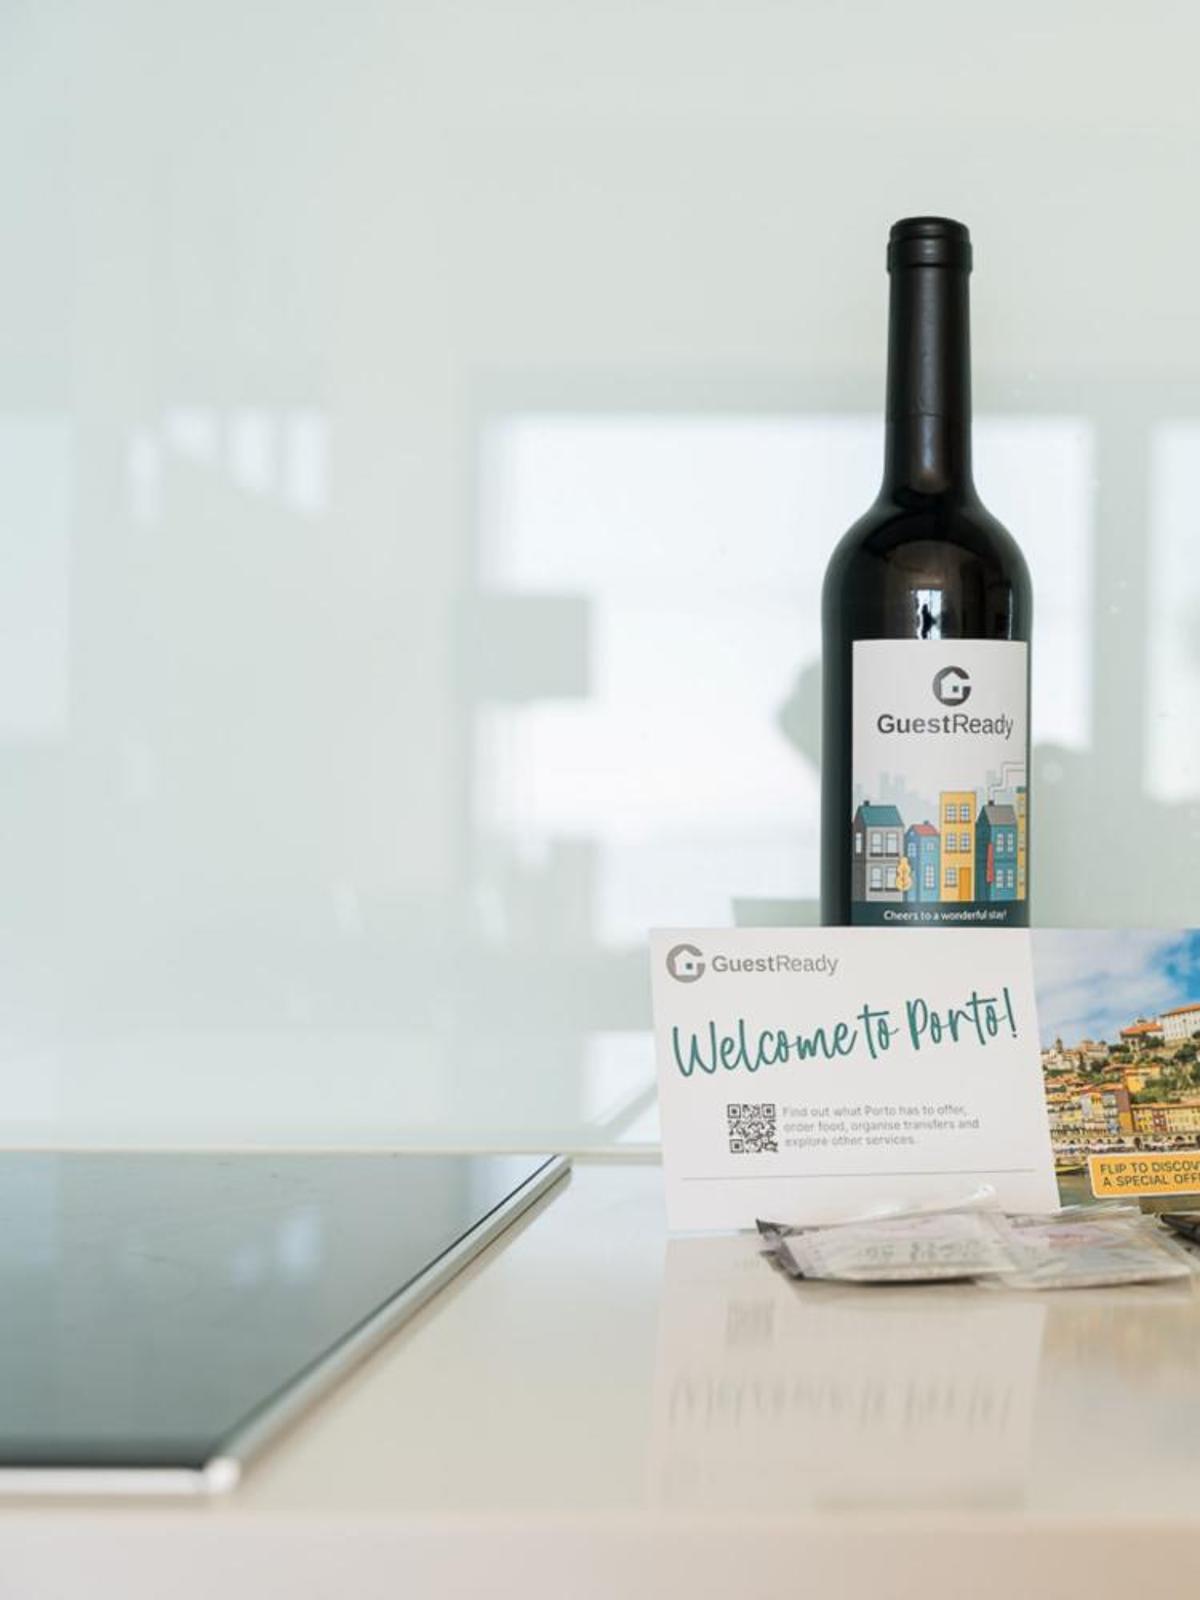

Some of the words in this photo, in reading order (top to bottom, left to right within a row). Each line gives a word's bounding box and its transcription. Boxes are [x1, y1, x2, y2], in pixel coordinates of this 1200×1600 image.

[877, 713, 1013, 740] GuestReady
[883, 909, 918, 921] Cheers
[920, 910, 932, 921] to
[933, 912, 940, 921] a
[941, 909, 987, 921] wonderful
[712, 953, 839, 977] GuestReady
[672, 1018, 858, 1078] Welcome
[857, 1003, 900, 1060] to
[905, 986, 1020, 1051] Porto!
[782, 1106, 808, 1117] Find
[810, 1106, 830, 1117] out
[834, 1105, 862, 1117] what
[864, 1104, 897, 1117] Porto
[899, 1104, 920, 1116] has
[922, 1104, 935, 1116] to
[783, 1120, 815, 1132] order
[851, 1119, 902, 1133] organise
[903, 1118, 955, 1130] transfers
[958, 1117, 980, 1130] and
[785, 1134, 829, 1148] explore
[831, 1134, 863, 1146] other
[1100, 1163, 1127, 1175] FLIP
[1131, 1162, 1149, 1174] TO
[1103, 1176, 1112, 1187] A
[1116, 1175, 1168, 1187] SPECIAL
